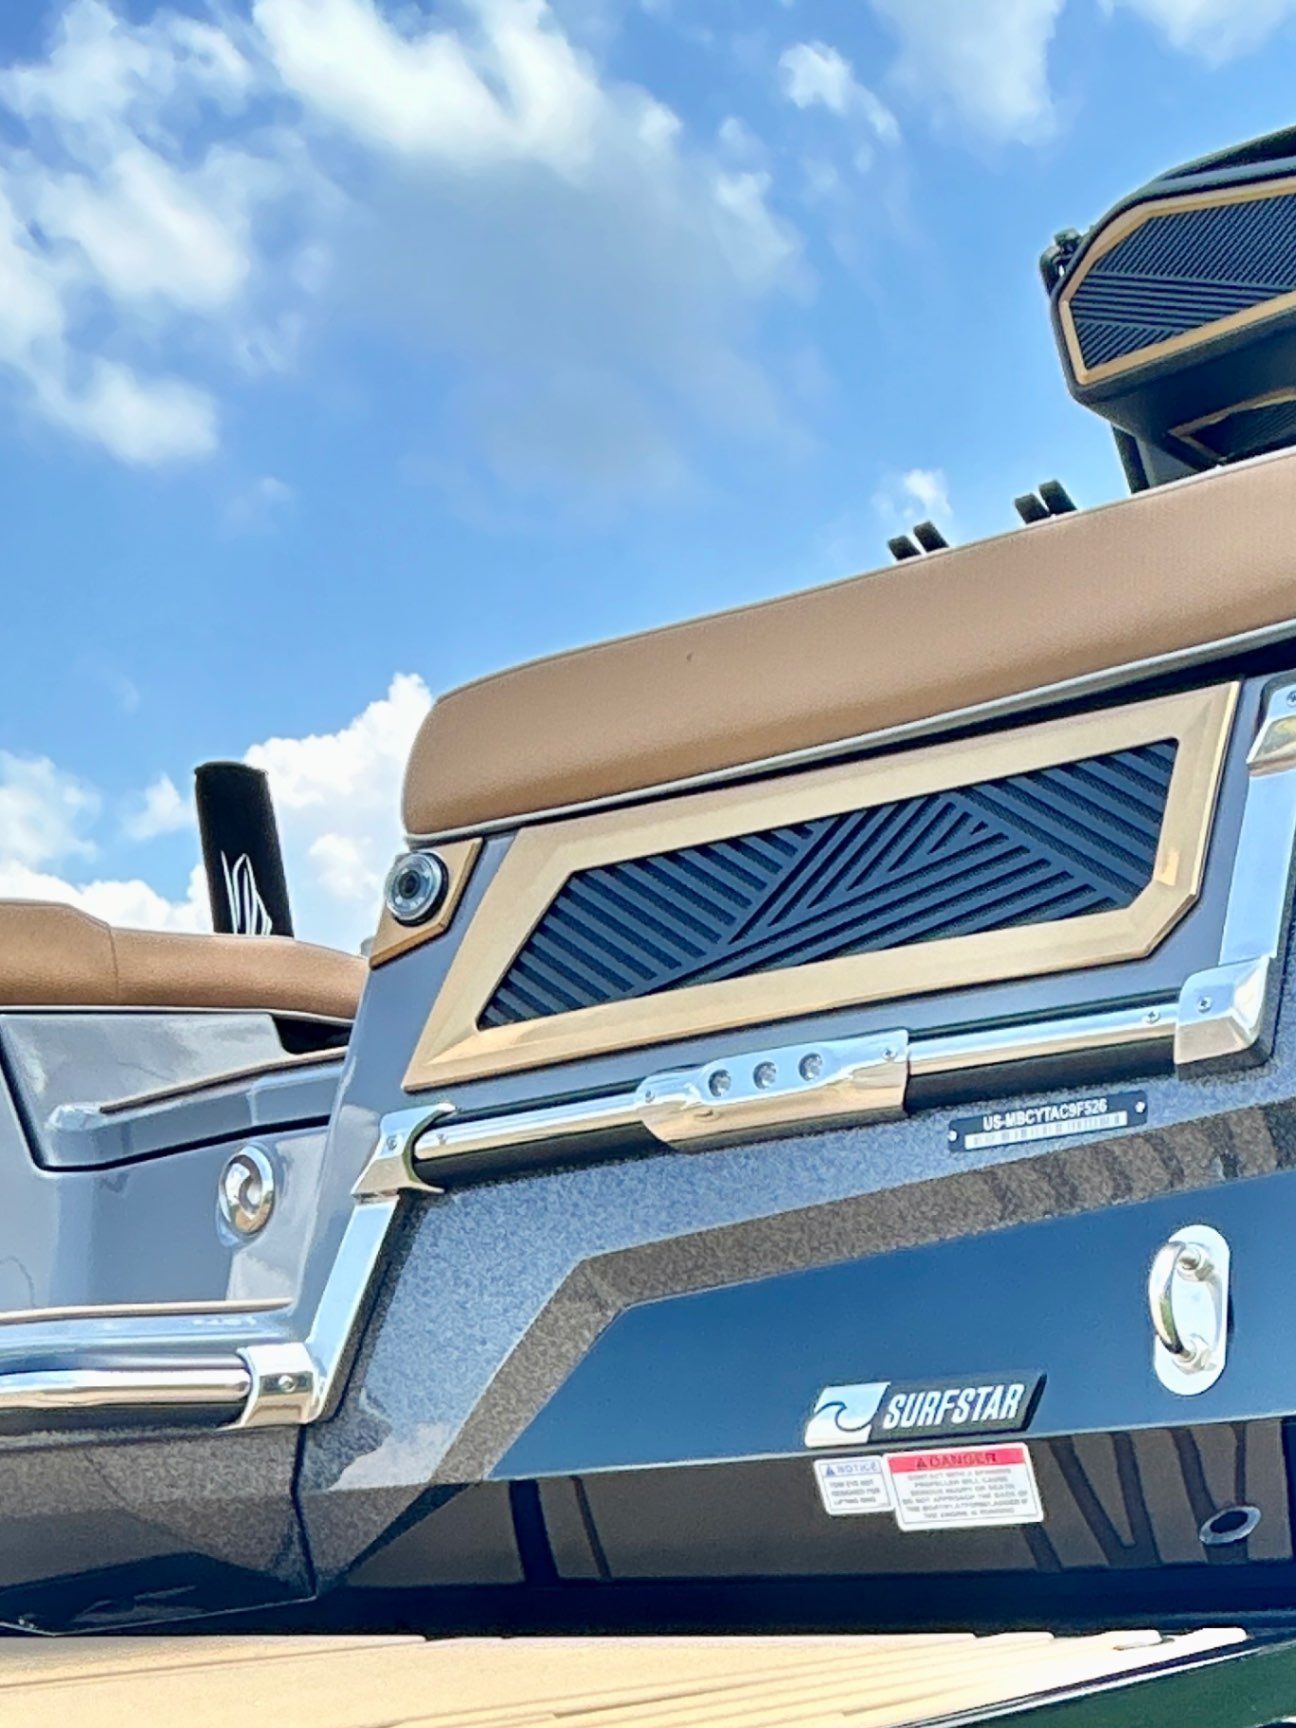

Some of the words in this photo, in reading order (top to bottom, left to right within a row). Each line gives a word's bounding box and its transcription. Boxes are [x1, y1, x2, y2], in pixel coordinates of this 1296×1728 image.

[883, 1383, 1025, 1430] SURFSTAR
[836, 1461, 878, 1474] NOTICE
[929, 1452, 997, 1468] DANGER
